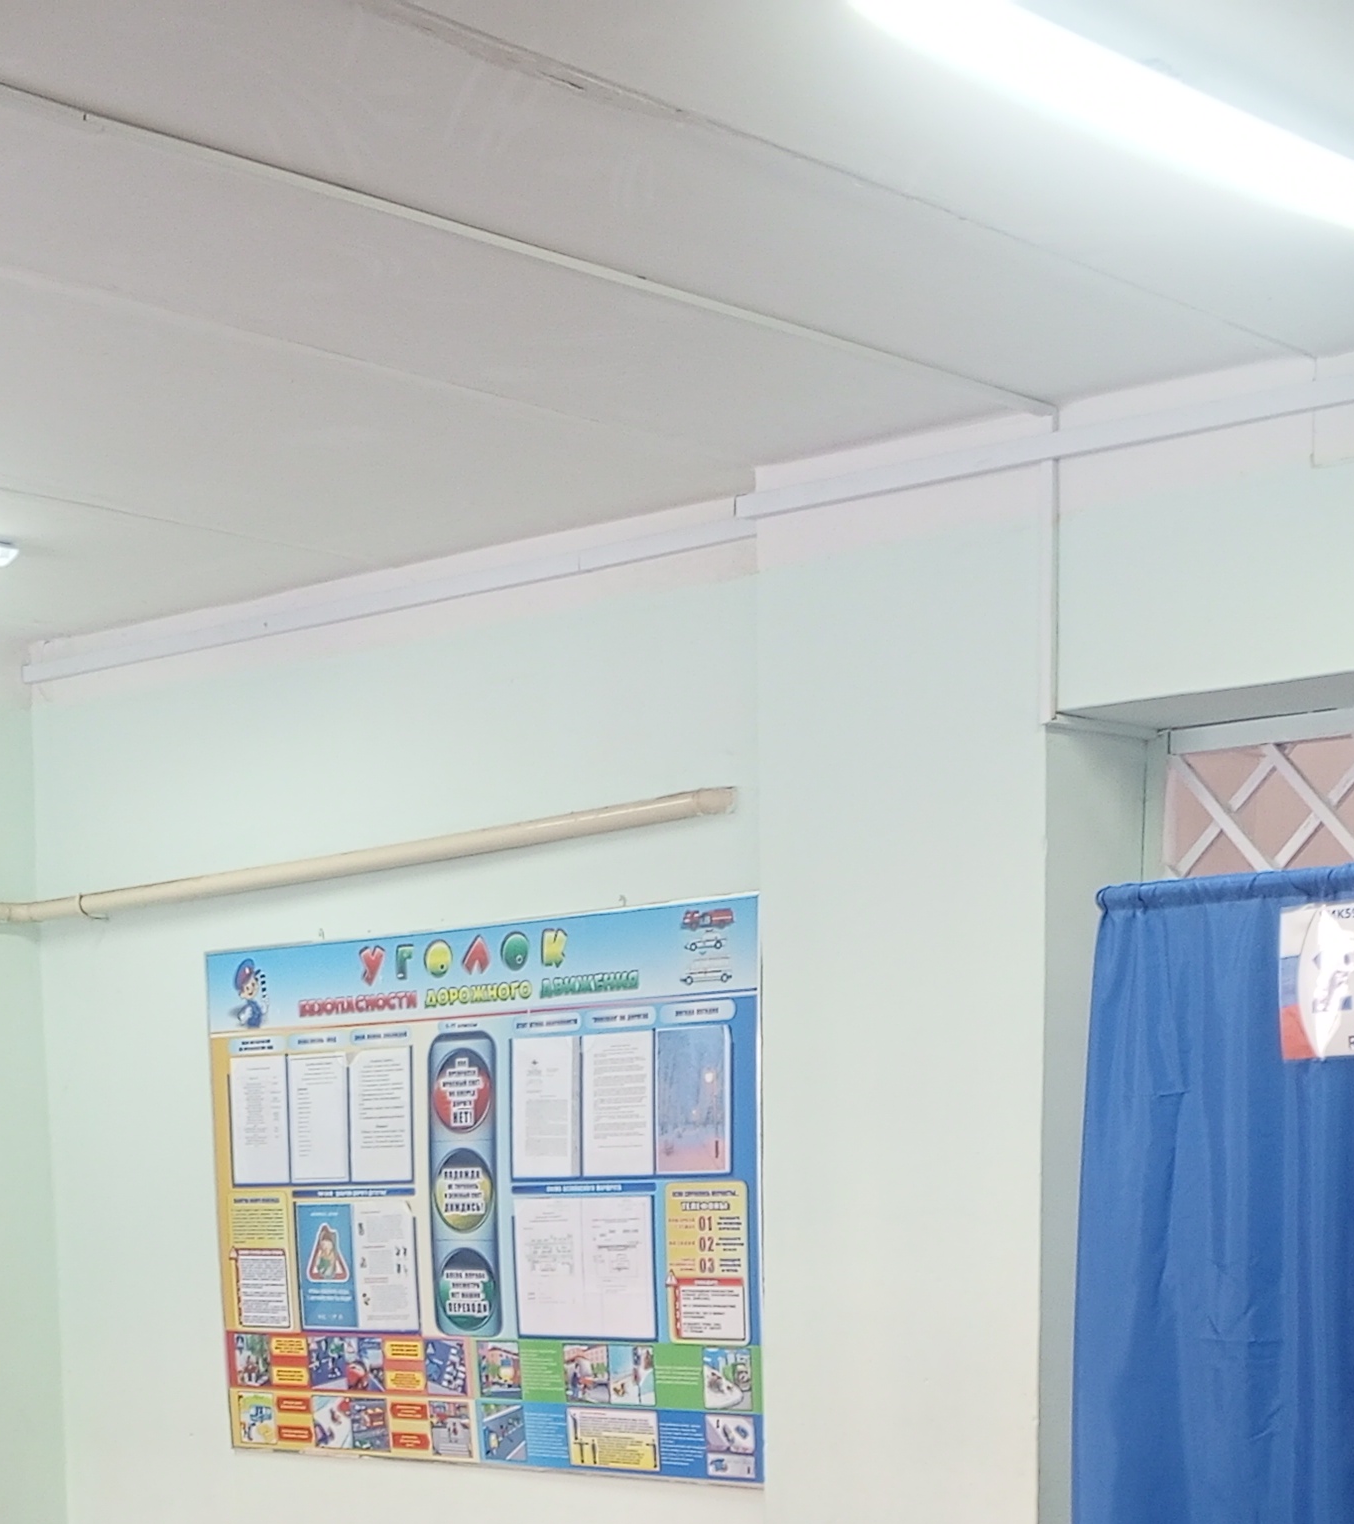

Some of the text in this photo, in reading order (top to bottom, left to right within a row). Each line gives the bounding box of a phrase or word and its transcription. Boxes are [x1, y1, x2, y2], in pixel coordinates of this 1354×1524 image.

[358, 928, 568, 986] УГОЛОК
[298, 970, 640, 1018] БЕЗОПАСНОСТИ ДОРОЖНОГО ДВИЖЕНИЯ
[698, 1216, 712, 1231] 01
[698, 1236, 714, 1252] 02
[699, 1257, 715, 1273] 03
